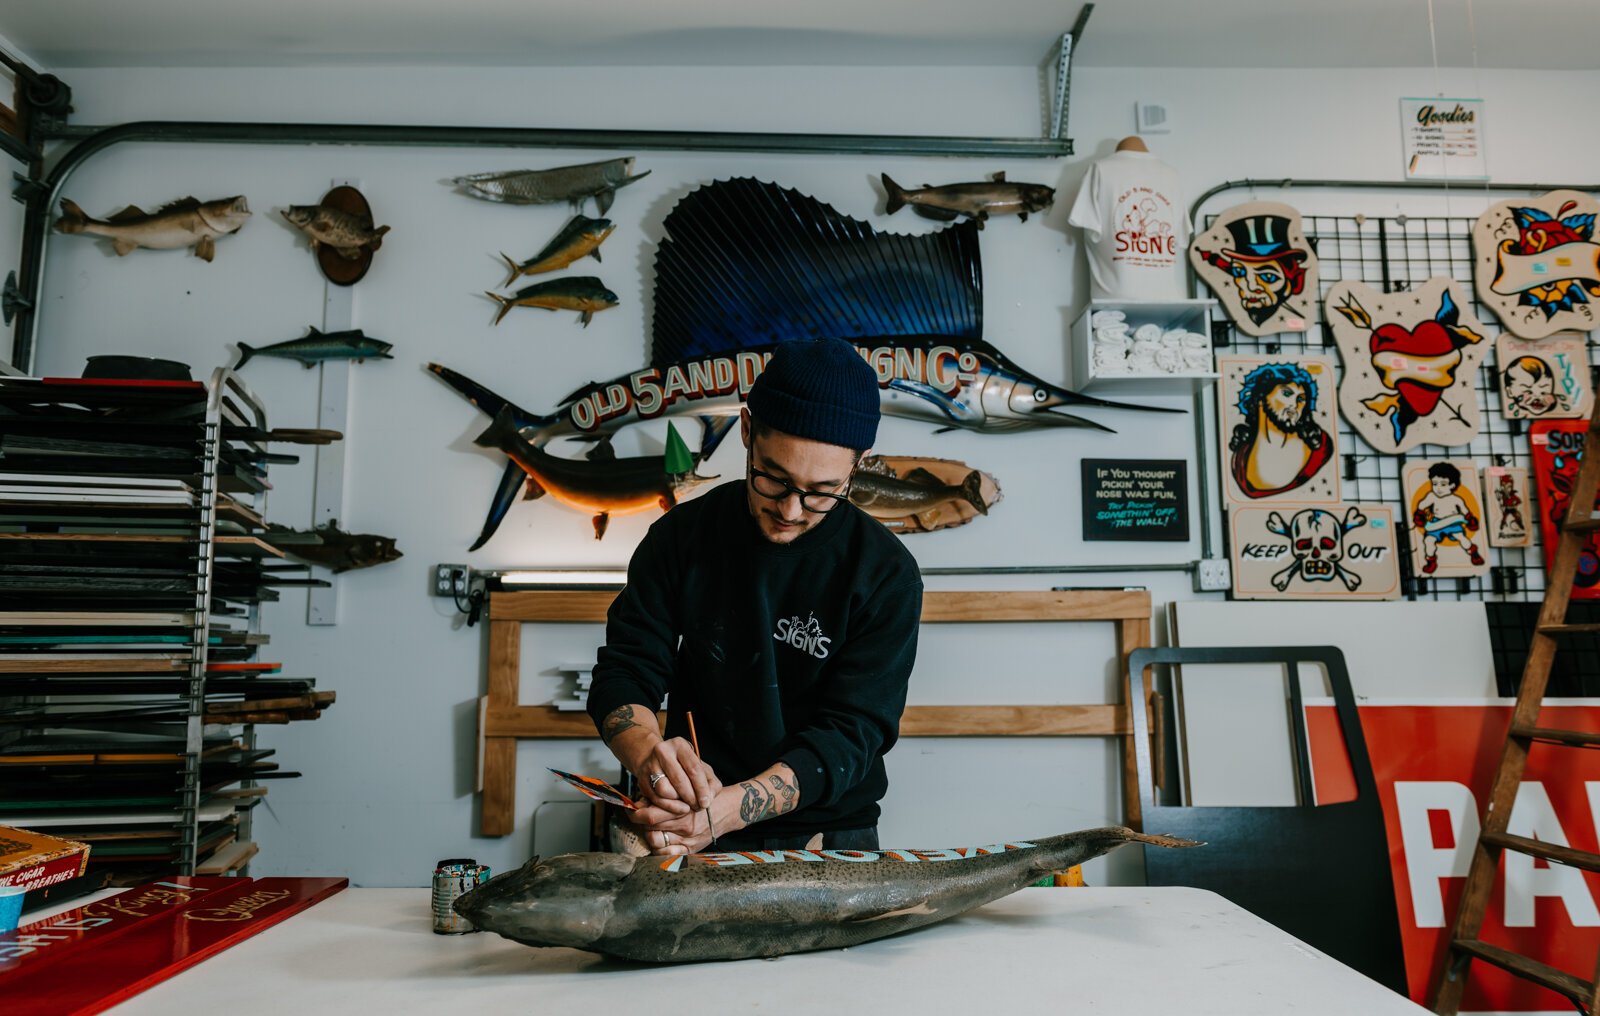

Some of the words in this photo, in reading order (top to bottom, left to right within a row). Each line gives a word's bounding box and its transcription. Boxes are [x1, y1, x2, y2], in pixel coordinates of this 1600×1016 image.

[1417, 103, 1475, 126] Goodies
[1115, 231, 1162, 254] SIGN
[570, 384, 630, 430] OLD
[630, 367, 666, 416] 5
[664, 357, 736, 400] AND
[1548, 429, 1586, 451] SOR
[1097, 468, 1109, 478] IF
[1110, 468, 1130, 478] YOU
[1132, 470, 1177, 479] THOUGHT
[1101, 480, 1135, 489] PICKIN'
[1138, 481, 1165, 489] YOUR
[1096, 490, 1122, 498] NOSE
[1115, 520, 1133, 528] THE
[1135, 516, 1170, 527] WALL!
[1241, 543, 1289, 559] KEEP
[1347, 543, 1388, 560] OUT
[773, 617, 832, 659] SIGNS
[1393, 780, 1600, 928] PA
[16, 866, 46, 884] CIGAR
[25, 868, 76, 891] BREATHES
